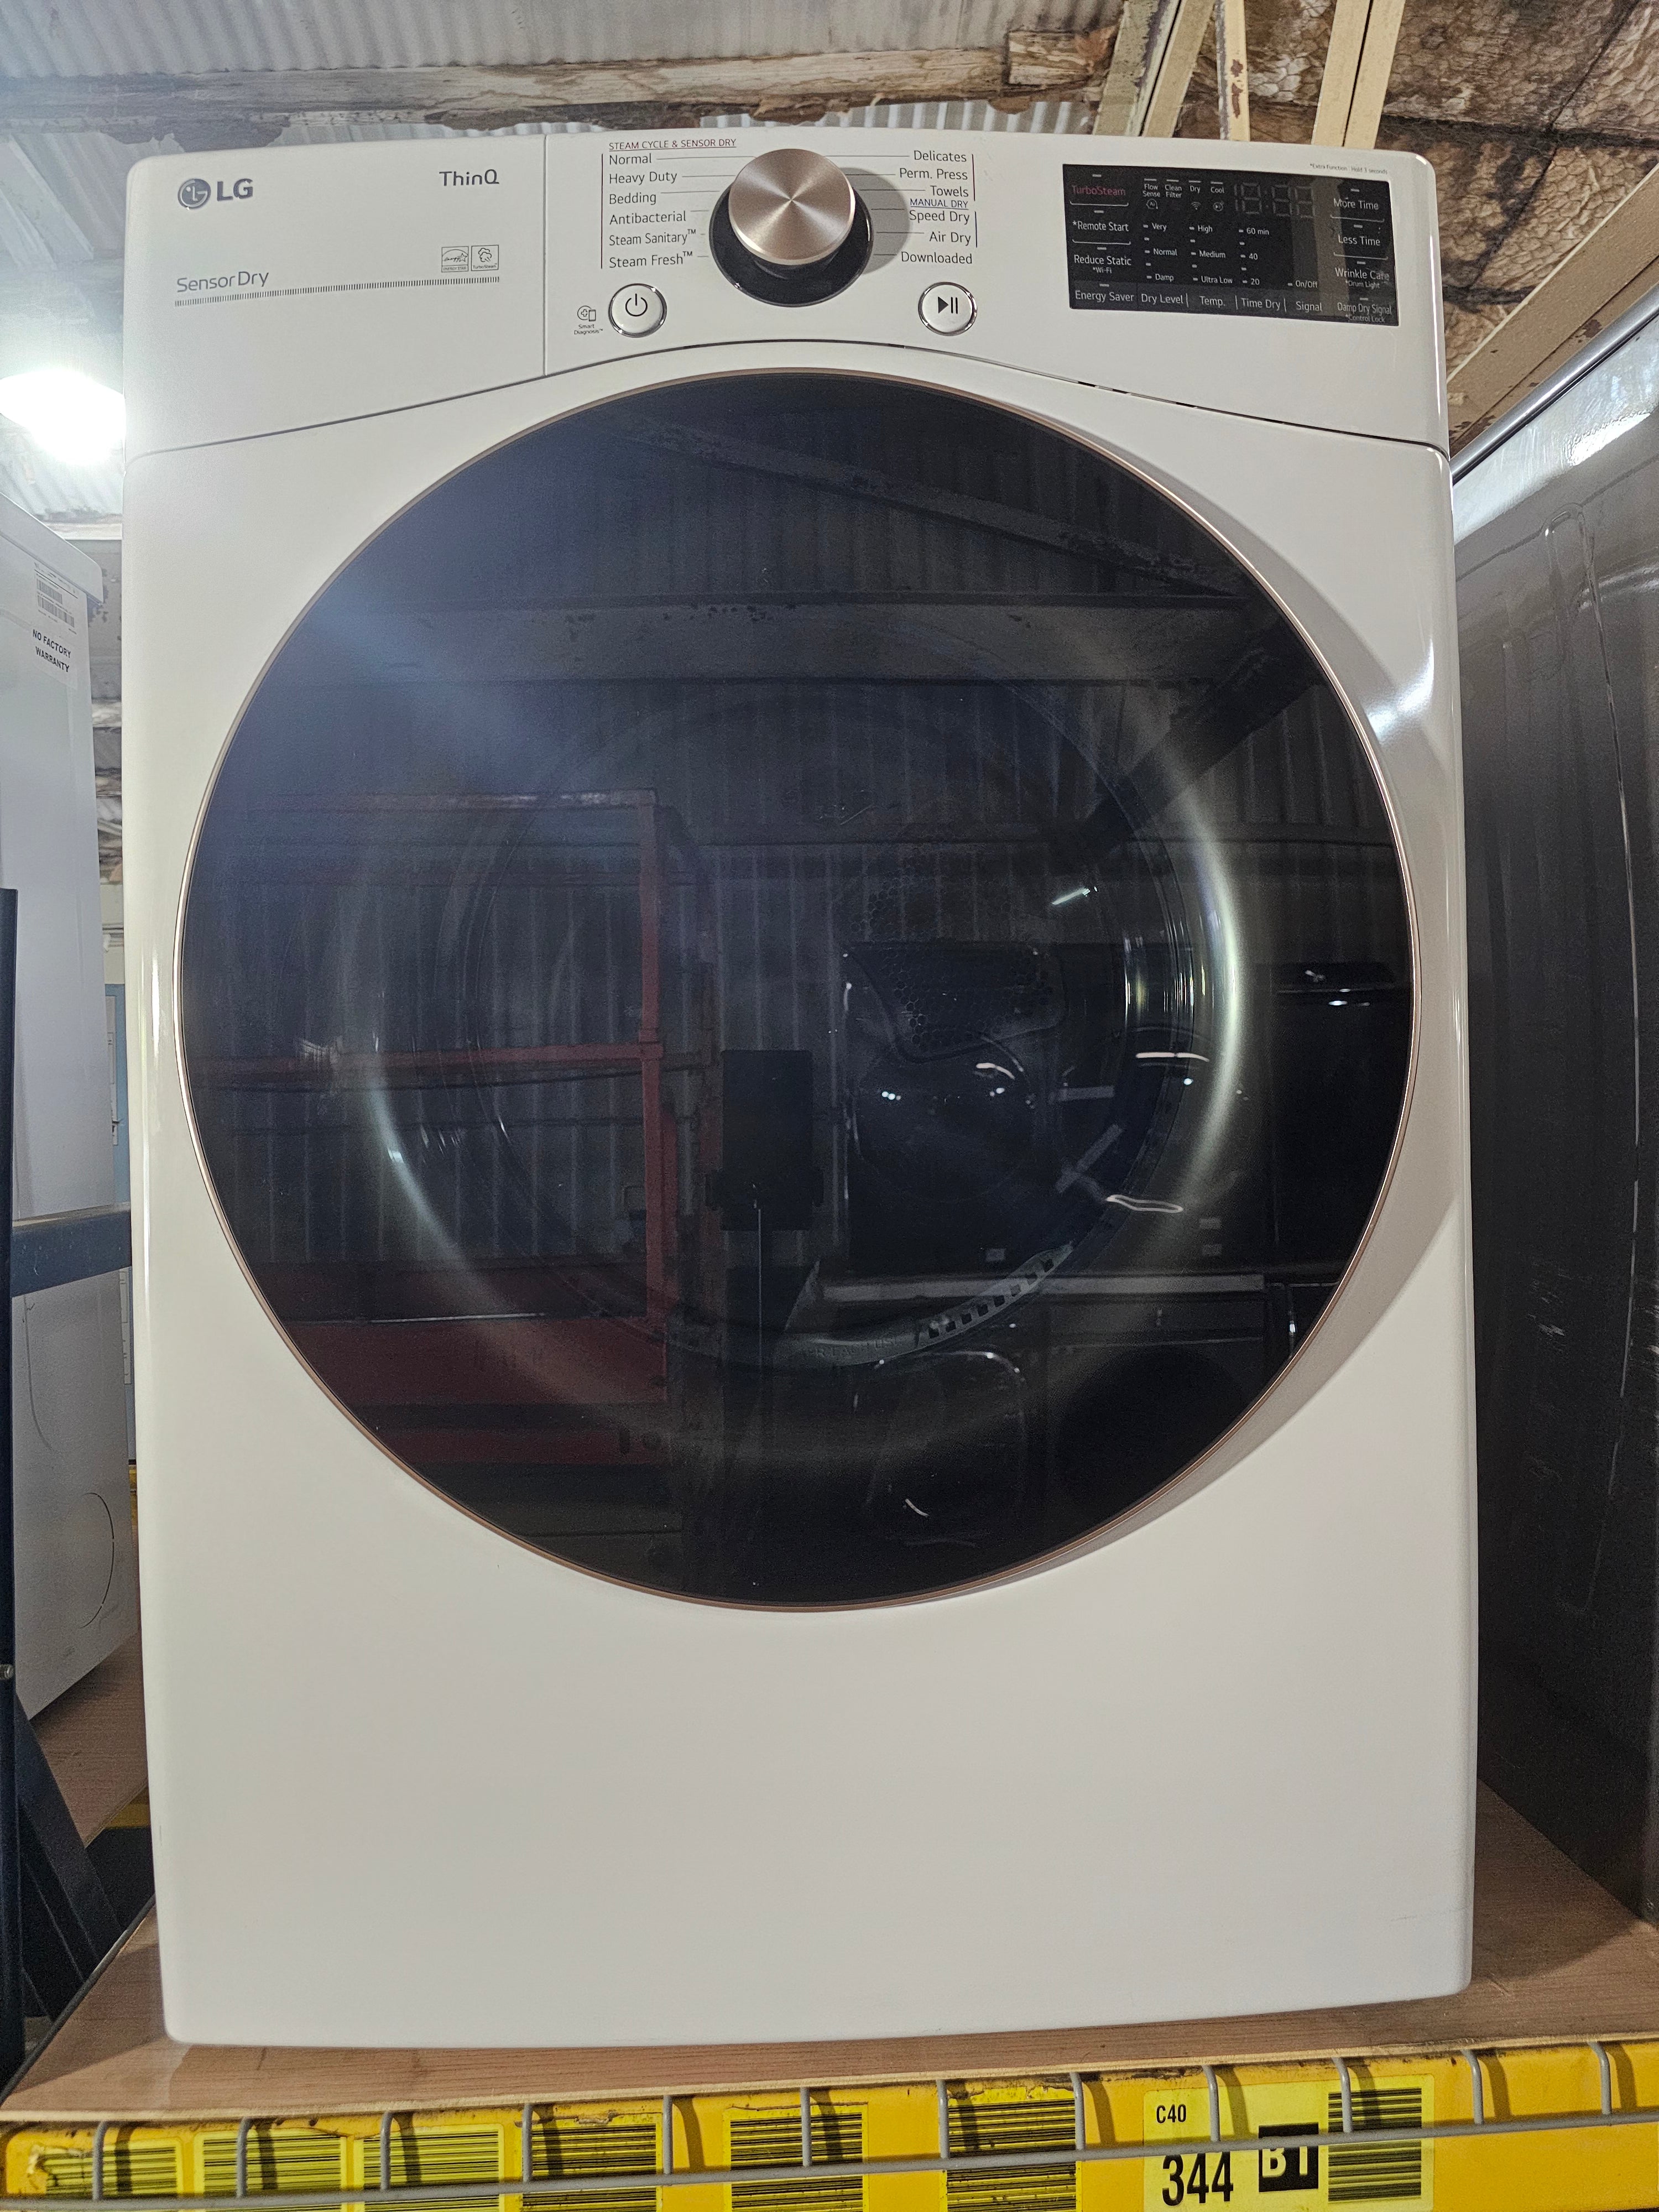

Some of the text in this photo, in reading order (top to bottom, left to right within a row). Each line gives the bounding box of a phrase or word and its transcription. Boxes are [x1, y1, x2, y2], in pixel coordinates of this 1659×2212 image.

[609, 153, 652, 165] Normal
[914, 150, 967, 162] Delicates
[439, 169, 499, 186] ThinQ
[609, 171, 677, 185] Heavy Duty
[899, 168, 968, 180] Perm. Press
[217, 178, 253, 201] LG
[930, 185, 969, 197] Towels
[1072, 185, 1126, 196] TurboSteam
[609, 192, 656, 205] Bedding
[910, 198, 968, 208] MANUAL DRY
[1333, 199, 1379, 210] More Time
[609, 211, 686, 225] Antibacterial
[909, 210, 969, 225] Speed Dry
[1109, 222, 1129, 232] Start
[1152, 223, 1167, 232] Very
[1197, 225, 1213, 234] High
[609, 234, 641, 246] Steam
[929, 231, 971, 246] Air Dry
[1338, 234, 1380, 246] Less Time
[609, 257, 646, 268] Steam
[901, 251, 972, 264] Downloaded
[1074, 254, 1132, 266] Reduce Static
[1155, 273, 1174, 282] Damp
[1334, 267, 1390, 281] Wrinkle Care
[1365, 281, 1380, 289] Light
[1074, 290, 1135, 302] Energy Saver
[1141, 294, 1183, 305] Dry Level
[1200, 296, 1225, 308] Temp.
[1240, 298, 1281, 310] Time Dry
[1296, 301, 1322, 312] Signal
[1337, 302, 1392, 316] Damp Dry Signal
[33, 629, 71, 659] NO FACTORY
[35, 645, 70, 672] WARRANTY
[1156, 2104, 1187, 2124] C40
[1162, 2151, 1234, 2206] 344
